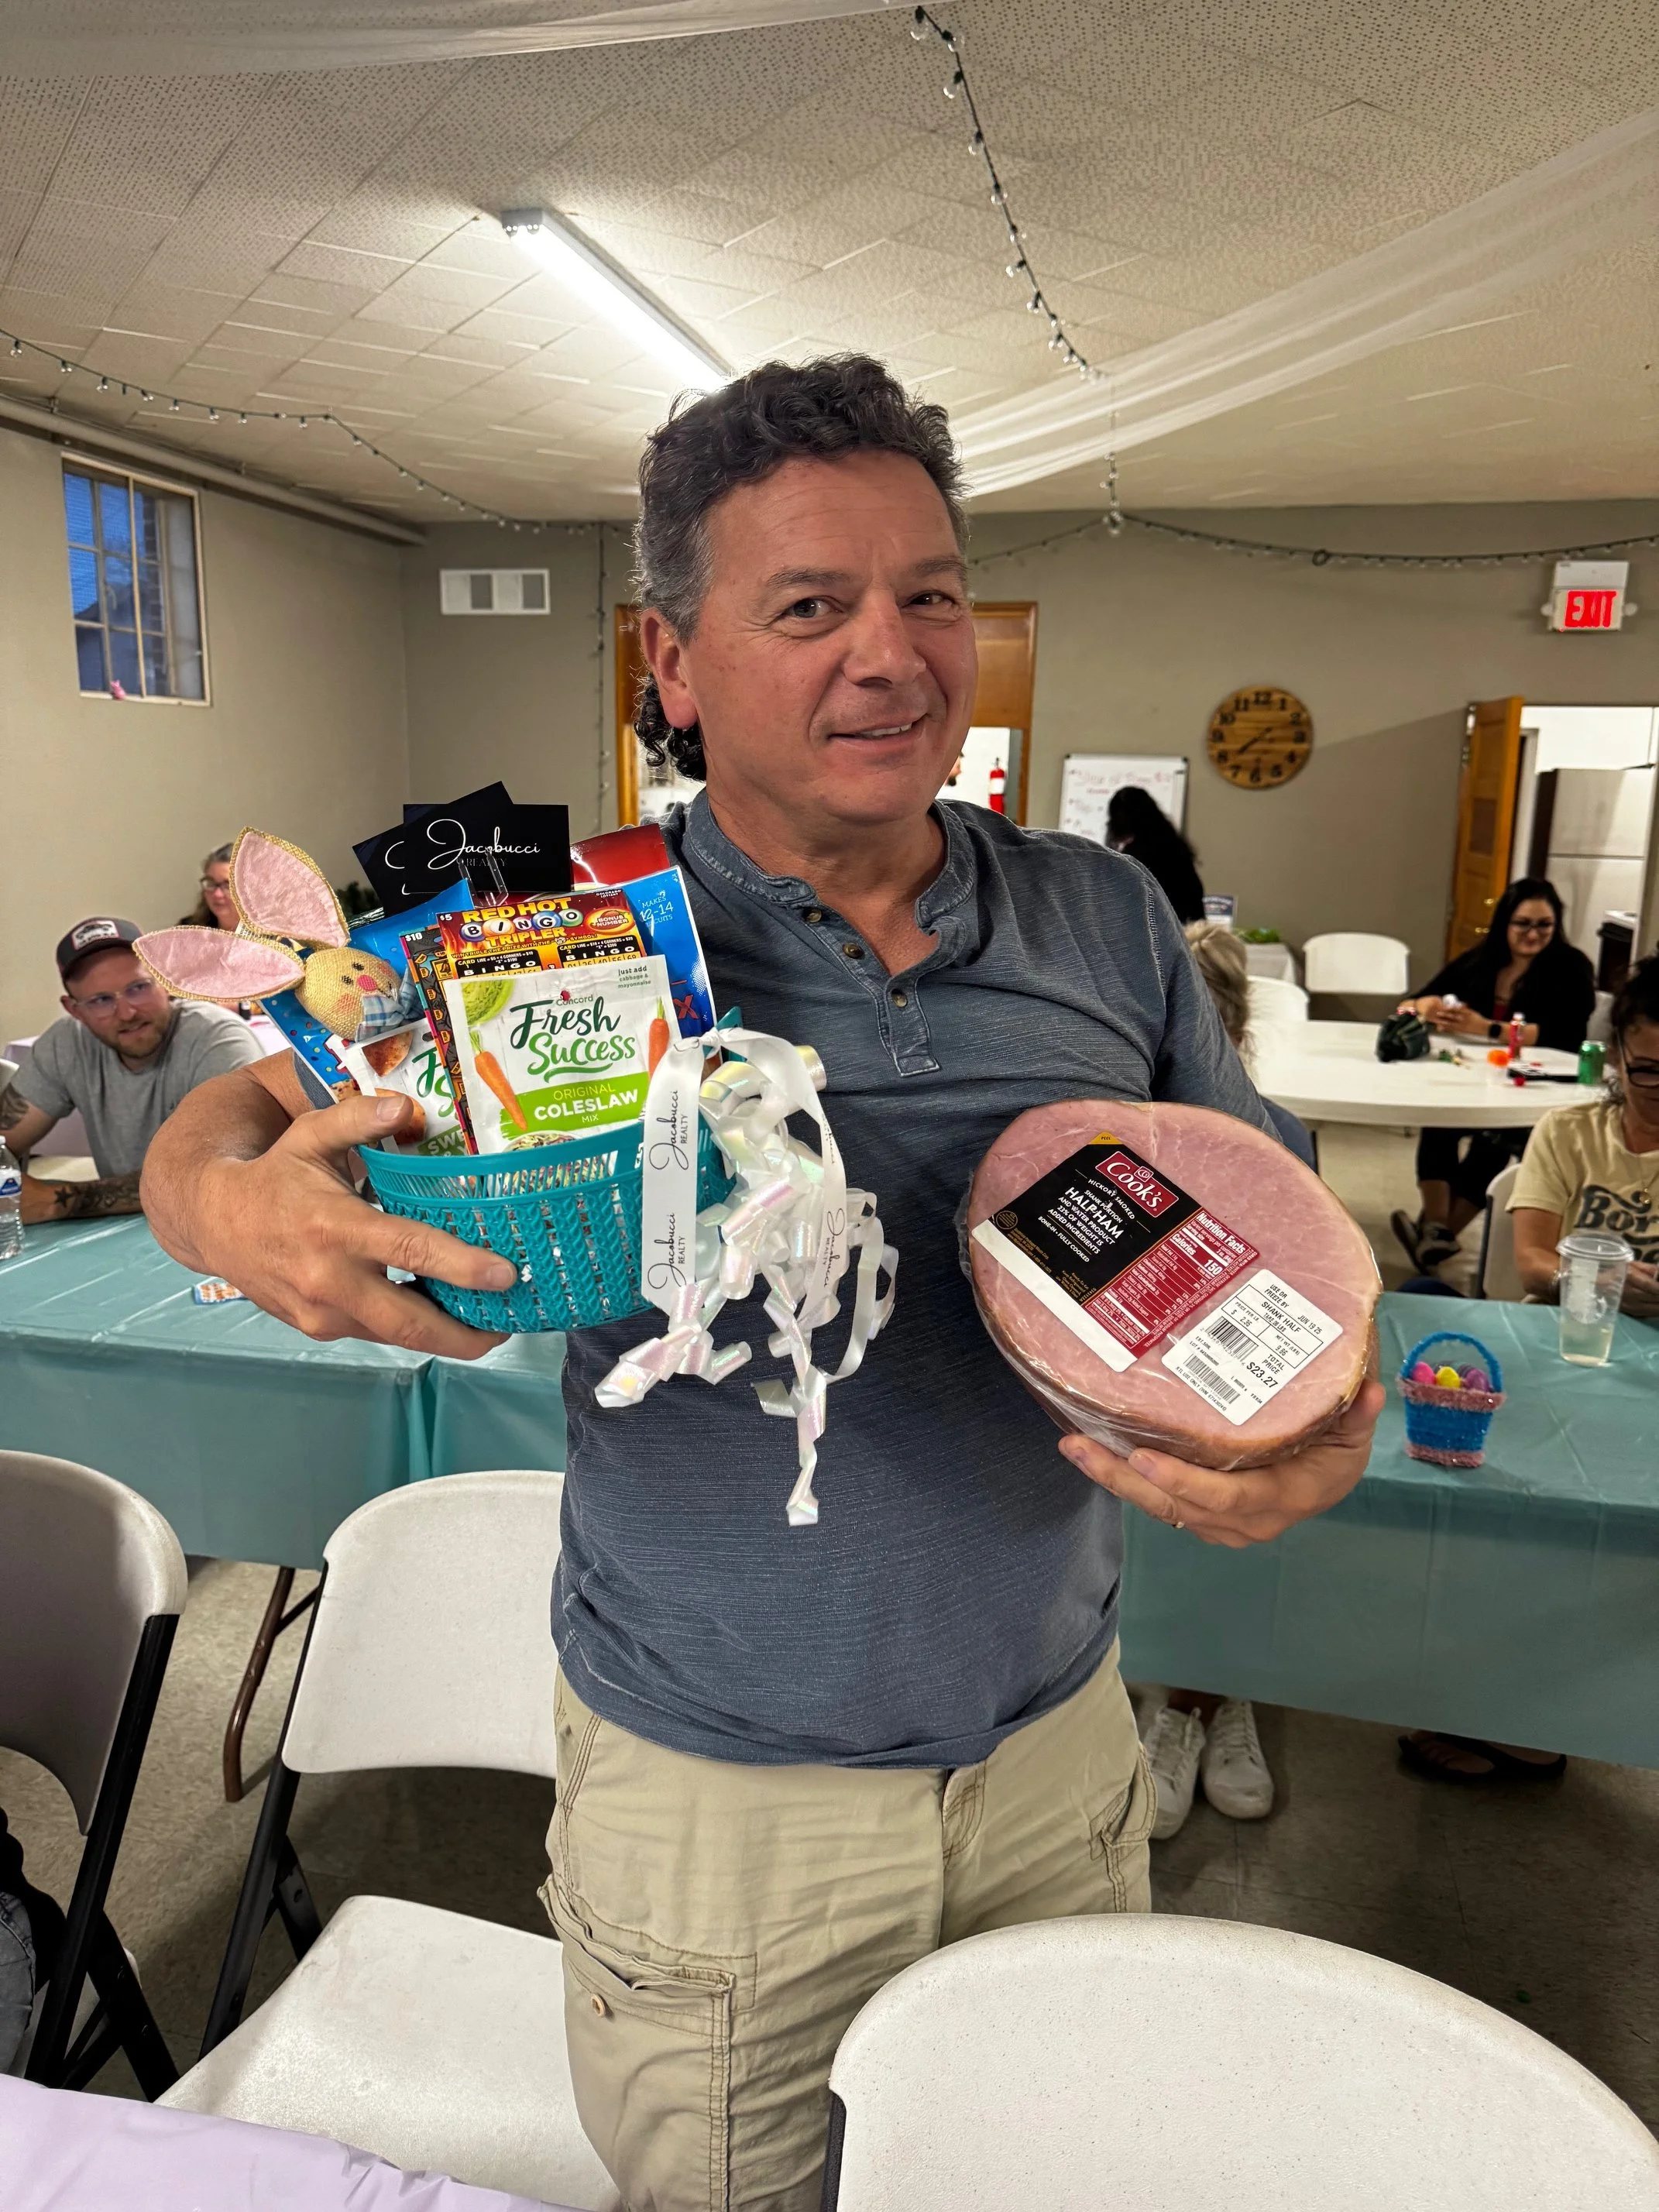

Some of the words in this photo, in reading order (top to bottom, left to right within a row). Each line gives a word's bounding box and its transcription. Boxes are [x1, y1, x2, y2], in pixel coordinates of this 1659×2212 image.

[1564, 590, 1616, 628] EXIT
[427, 819, 540, 870] Jacobucci
[462, 905, 515, 923] RED
[518, 897, 572, 917] HOT
[642, 896, 666, 908] MAKES
[465, 909, 577, 936] BINGO
[596, 919, 629, 927] NUMBER
[405, 932, 423, 942] $10
[486, 926, 567, 947] TRIPLER
[619, 974, 644, 982] cabbage
[634, 965, 647, 974] add
[617, 980, 651, 989] mayonnaise
[510, 996, 621, 1049] Fresh
[527, 1032, 637, 1076] Success
[534, 1089, 638, 1121] COLESLAW
[553, 1084, 616, 1101] ORIGINAL
[582, 1115, 599, 1123] MIX
[649, 1090, 689, 1170] Jacobucci
[680, 1115, 689, 1144] REALTY
[1087, 1178, 1115, 1197] HICKORY
[1115, 1196, 1135, 1219] SMOKED
[1107, 1163, 1163, 1214] Cook's
[1064, 1186, 1097, 1214] HALF
[1091, 1210, 1123, 1238] HAM
[1084, 1190, 1101, 1204] SHANK
[1099, 1202, 1122, 1223] PORTION
[1048, 1208, 1066, 1224] ADDED
[1065, 1222, 1100, 1254] INGREDIENTS
[1057, 1205, 1069, 1215] 23%
[1067, 1214, 1077, 1222] OF
[1075, 1221, 1097, 1241] WEIGHT
[1058, 1196, 1071, 1207] AND
[1070, 1205, 1089, 1223] WATER
[1087, 1221, 1115, 1245] PRODUCT
[1185, 1223, 1198, 1235] Serving
[1196, 1212, 1228, 1240] Nutrition
[1224, 1235, 1246, 1254] Facts
[1038, 1216, 1056, 1232] BONE-IN
[1056, 1232, 1071, 1245] FULLY
[1070, 1245, 1090, 1262] COOKED
[1200, 1229, 1215, 1243] servings
[647, 1211, 687, 1290] Jacobucci
[1171, 1233, 1197, 1255] Calories
[1204, 1259, 1223, 1276] 150
[1264, 1288, 1282, 1304] FREEZE
[1269, 1283, 1280, 1293] USE
[1235, 1301, 1245, 1311] PRICE
[1261, 1301, 1283, 1320] SHANK
[1282, 1317, 1300, 1333] HALF
[1262, 1313, 1274, 1323] TARE
[1297, 1314, 1309, 1324] JUN
[1245, 1362, 1278, 1389] $23.27
[1262, 1359, 1279, 1374] PRICE
[1267, 1354, 1285, 1370] TOTAL
[1190, 1379, 1200, 1387] ONLY
